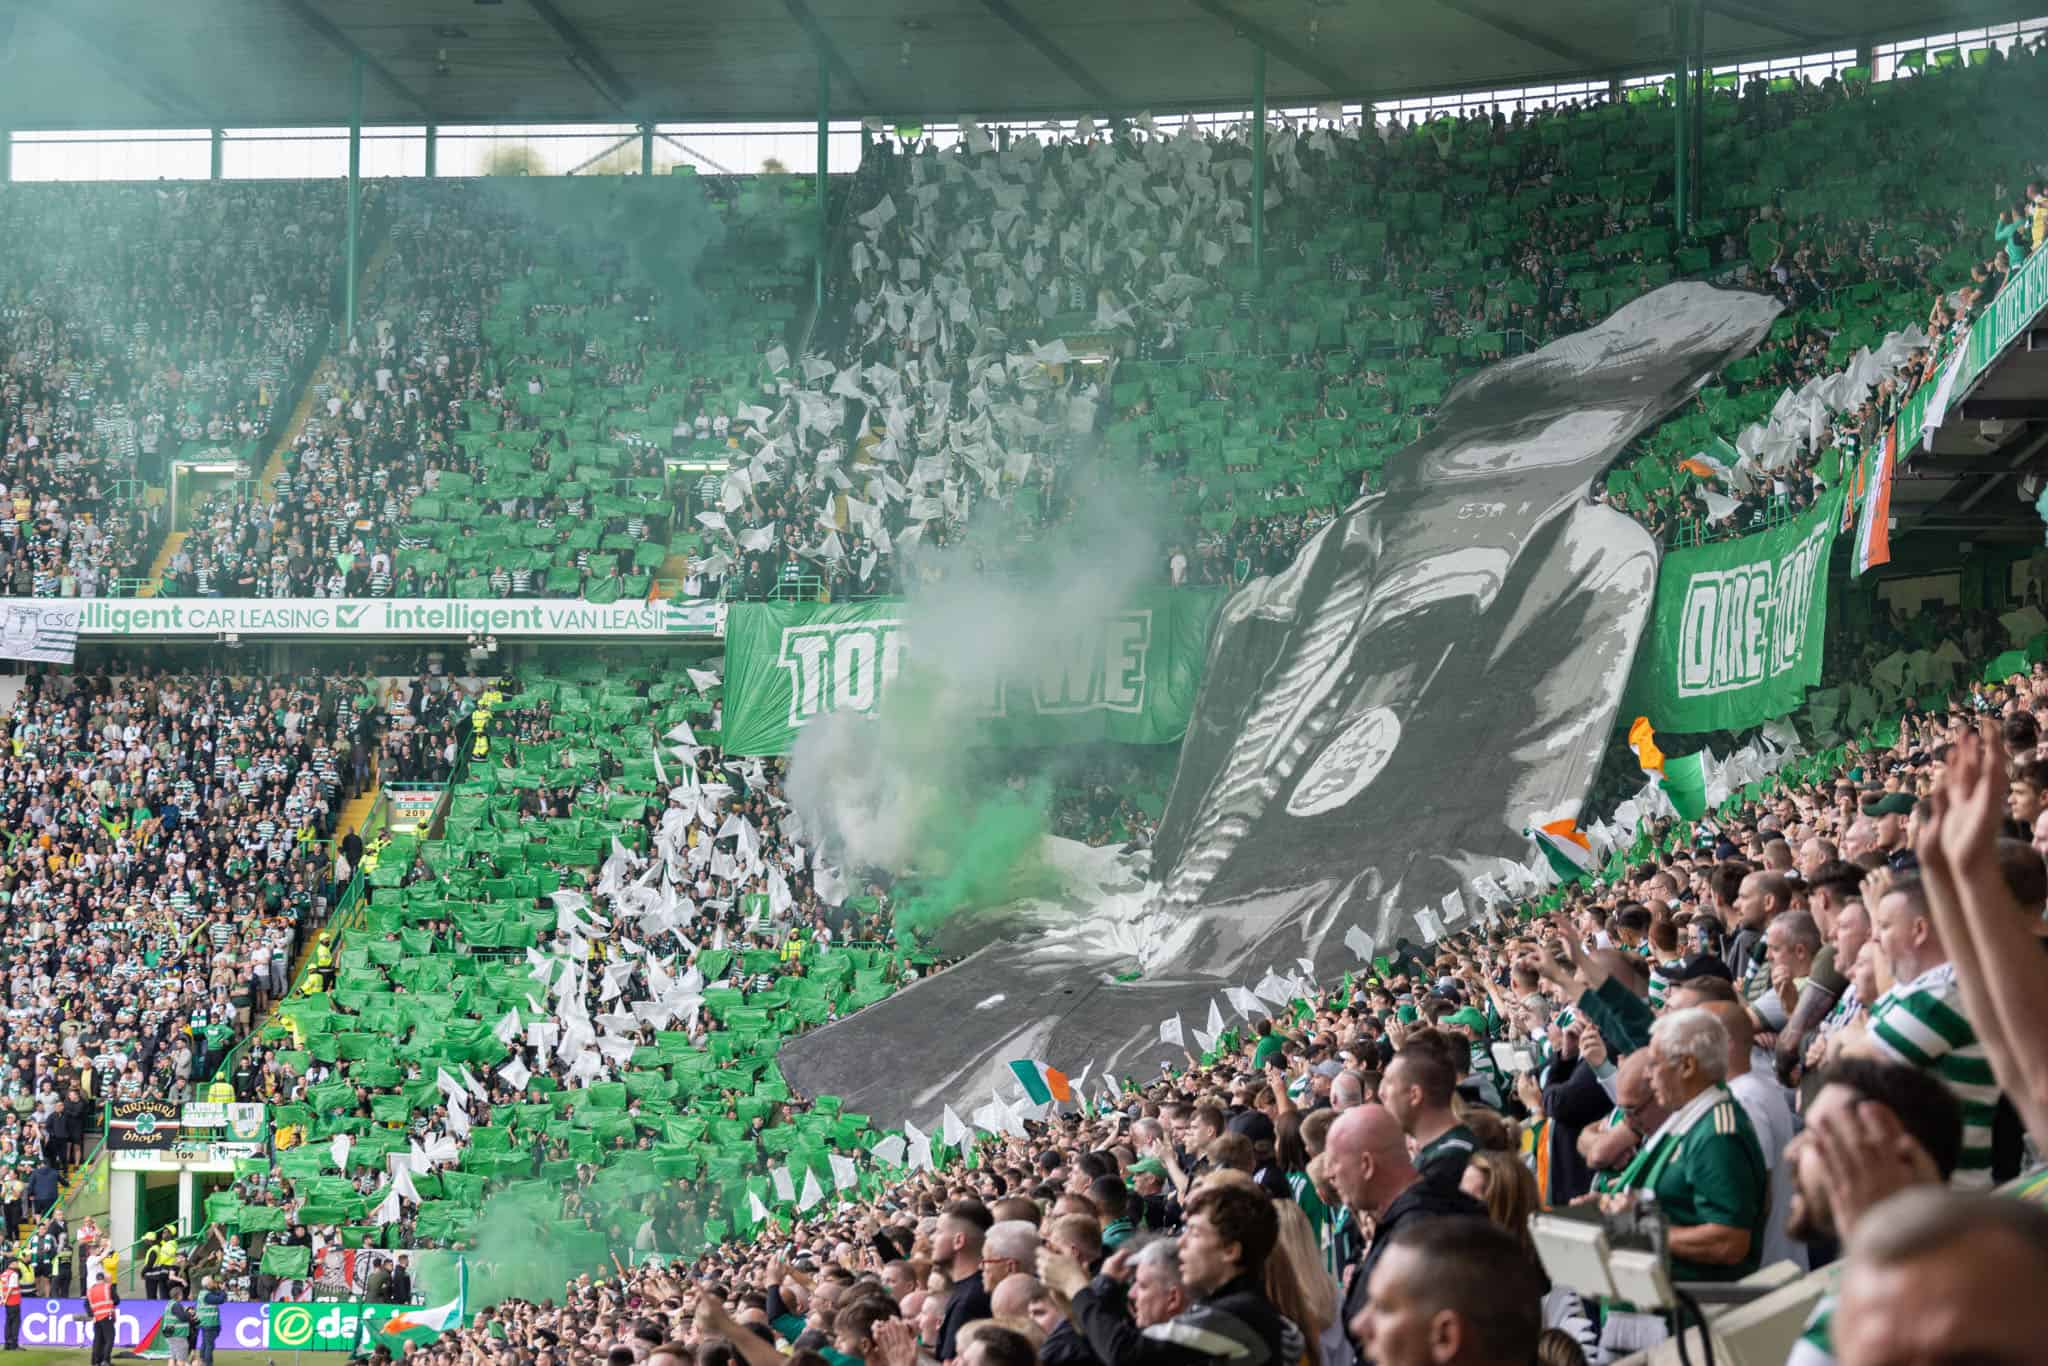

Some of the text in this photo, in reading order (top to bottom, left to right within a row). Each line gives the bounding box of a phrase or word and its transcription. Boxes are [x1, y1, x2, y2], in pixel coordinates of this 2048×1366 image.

[80, 602, 329, 633] lligent CAR LEASING
[385, 602, 543, 633] intelligent
[550, 609, 597, 629] VAN
[1681, 566, 1769, 692] DARE
